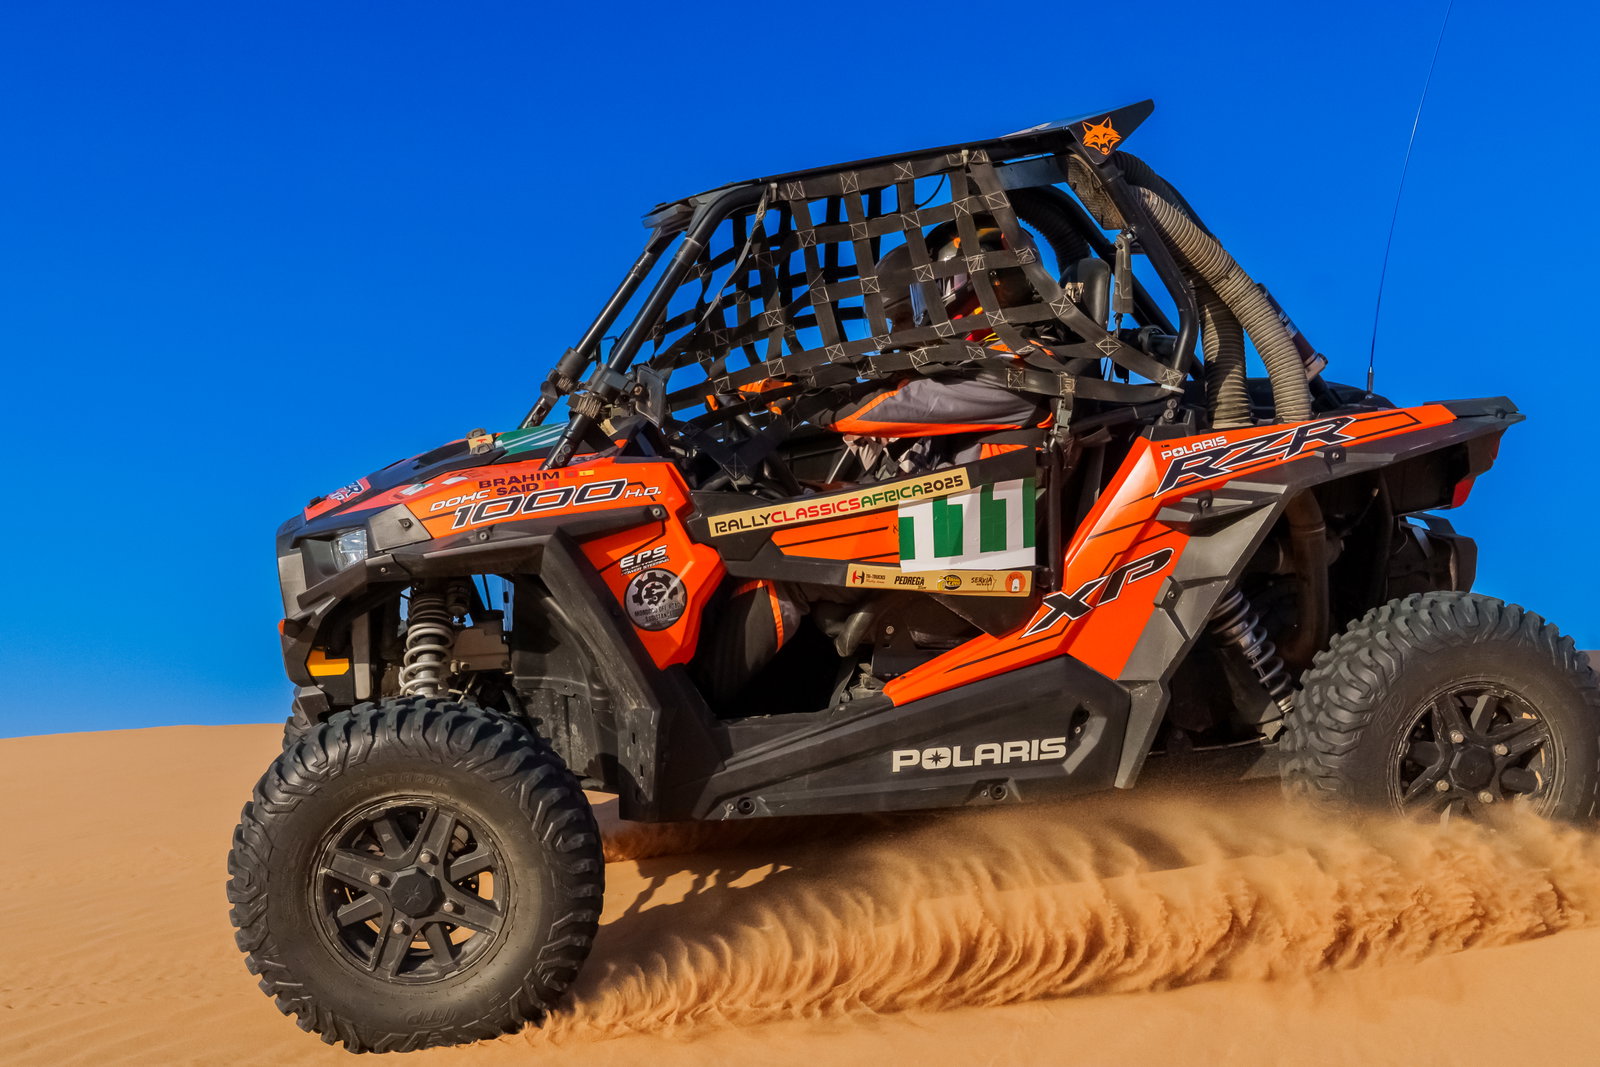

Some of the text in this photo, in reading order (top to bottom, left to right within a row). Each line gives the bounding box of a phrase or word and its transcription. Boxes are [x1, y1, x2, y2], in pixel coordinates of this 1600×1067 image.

[1153, 416, 1356, 498] RZR
[1161, 436, 1227, 460] POLARIS
[479, 471, 560, 489] BRAHIM
[496, 482, 540, 497] SAID
[429, 489, 491, 512] DOHC
[451, 478, 628, 529] 1000
[898, 478, 1036, 572] 111
[620, 545, 667, 567] EPS
[1020, 547, 1175, 639] XP
[892, 736, 1067, 773] POLARIS
